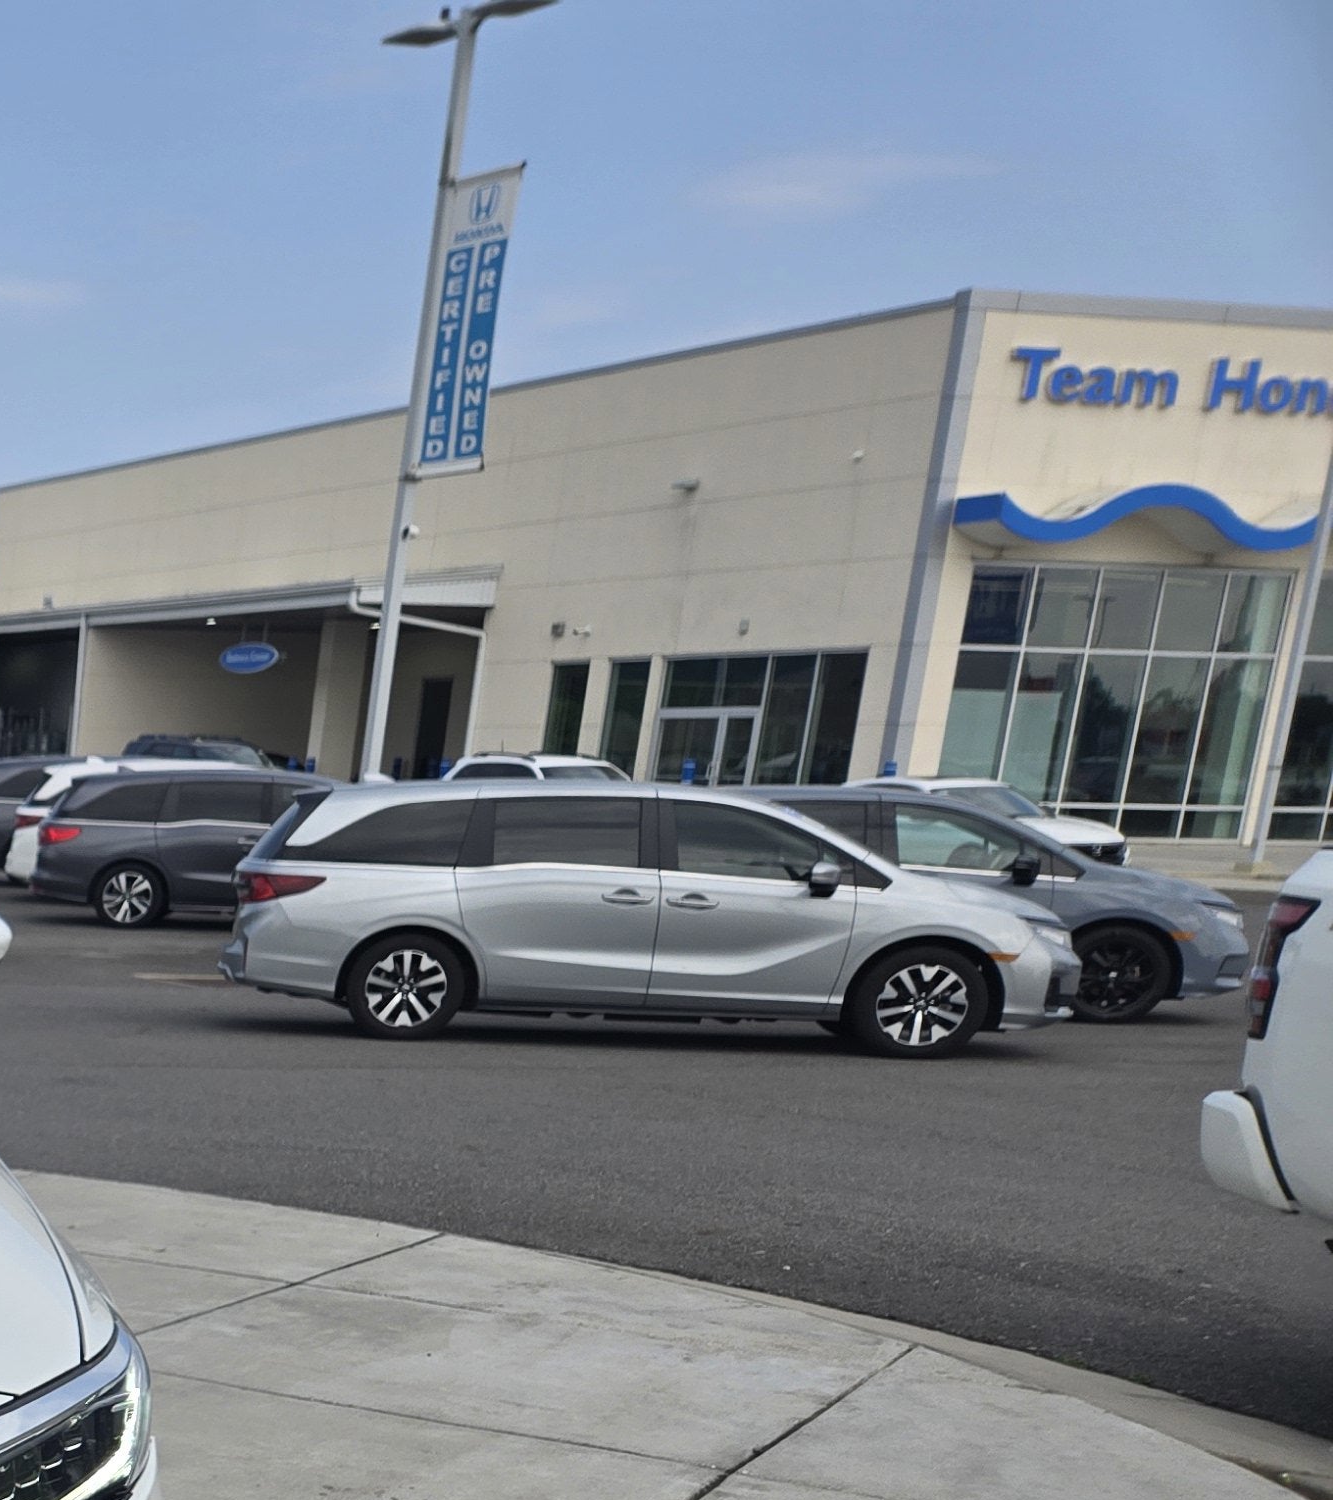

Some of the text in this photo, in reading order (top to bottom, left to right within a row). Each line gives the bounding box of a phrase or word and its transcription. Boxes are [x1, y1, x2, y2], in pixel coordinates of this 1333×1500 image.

[425, 251, 469, 459] CERTIFIED
[460, 243, 501, 456] PRE OWNED
[1012, 345, 1331, 415] Team Hon
